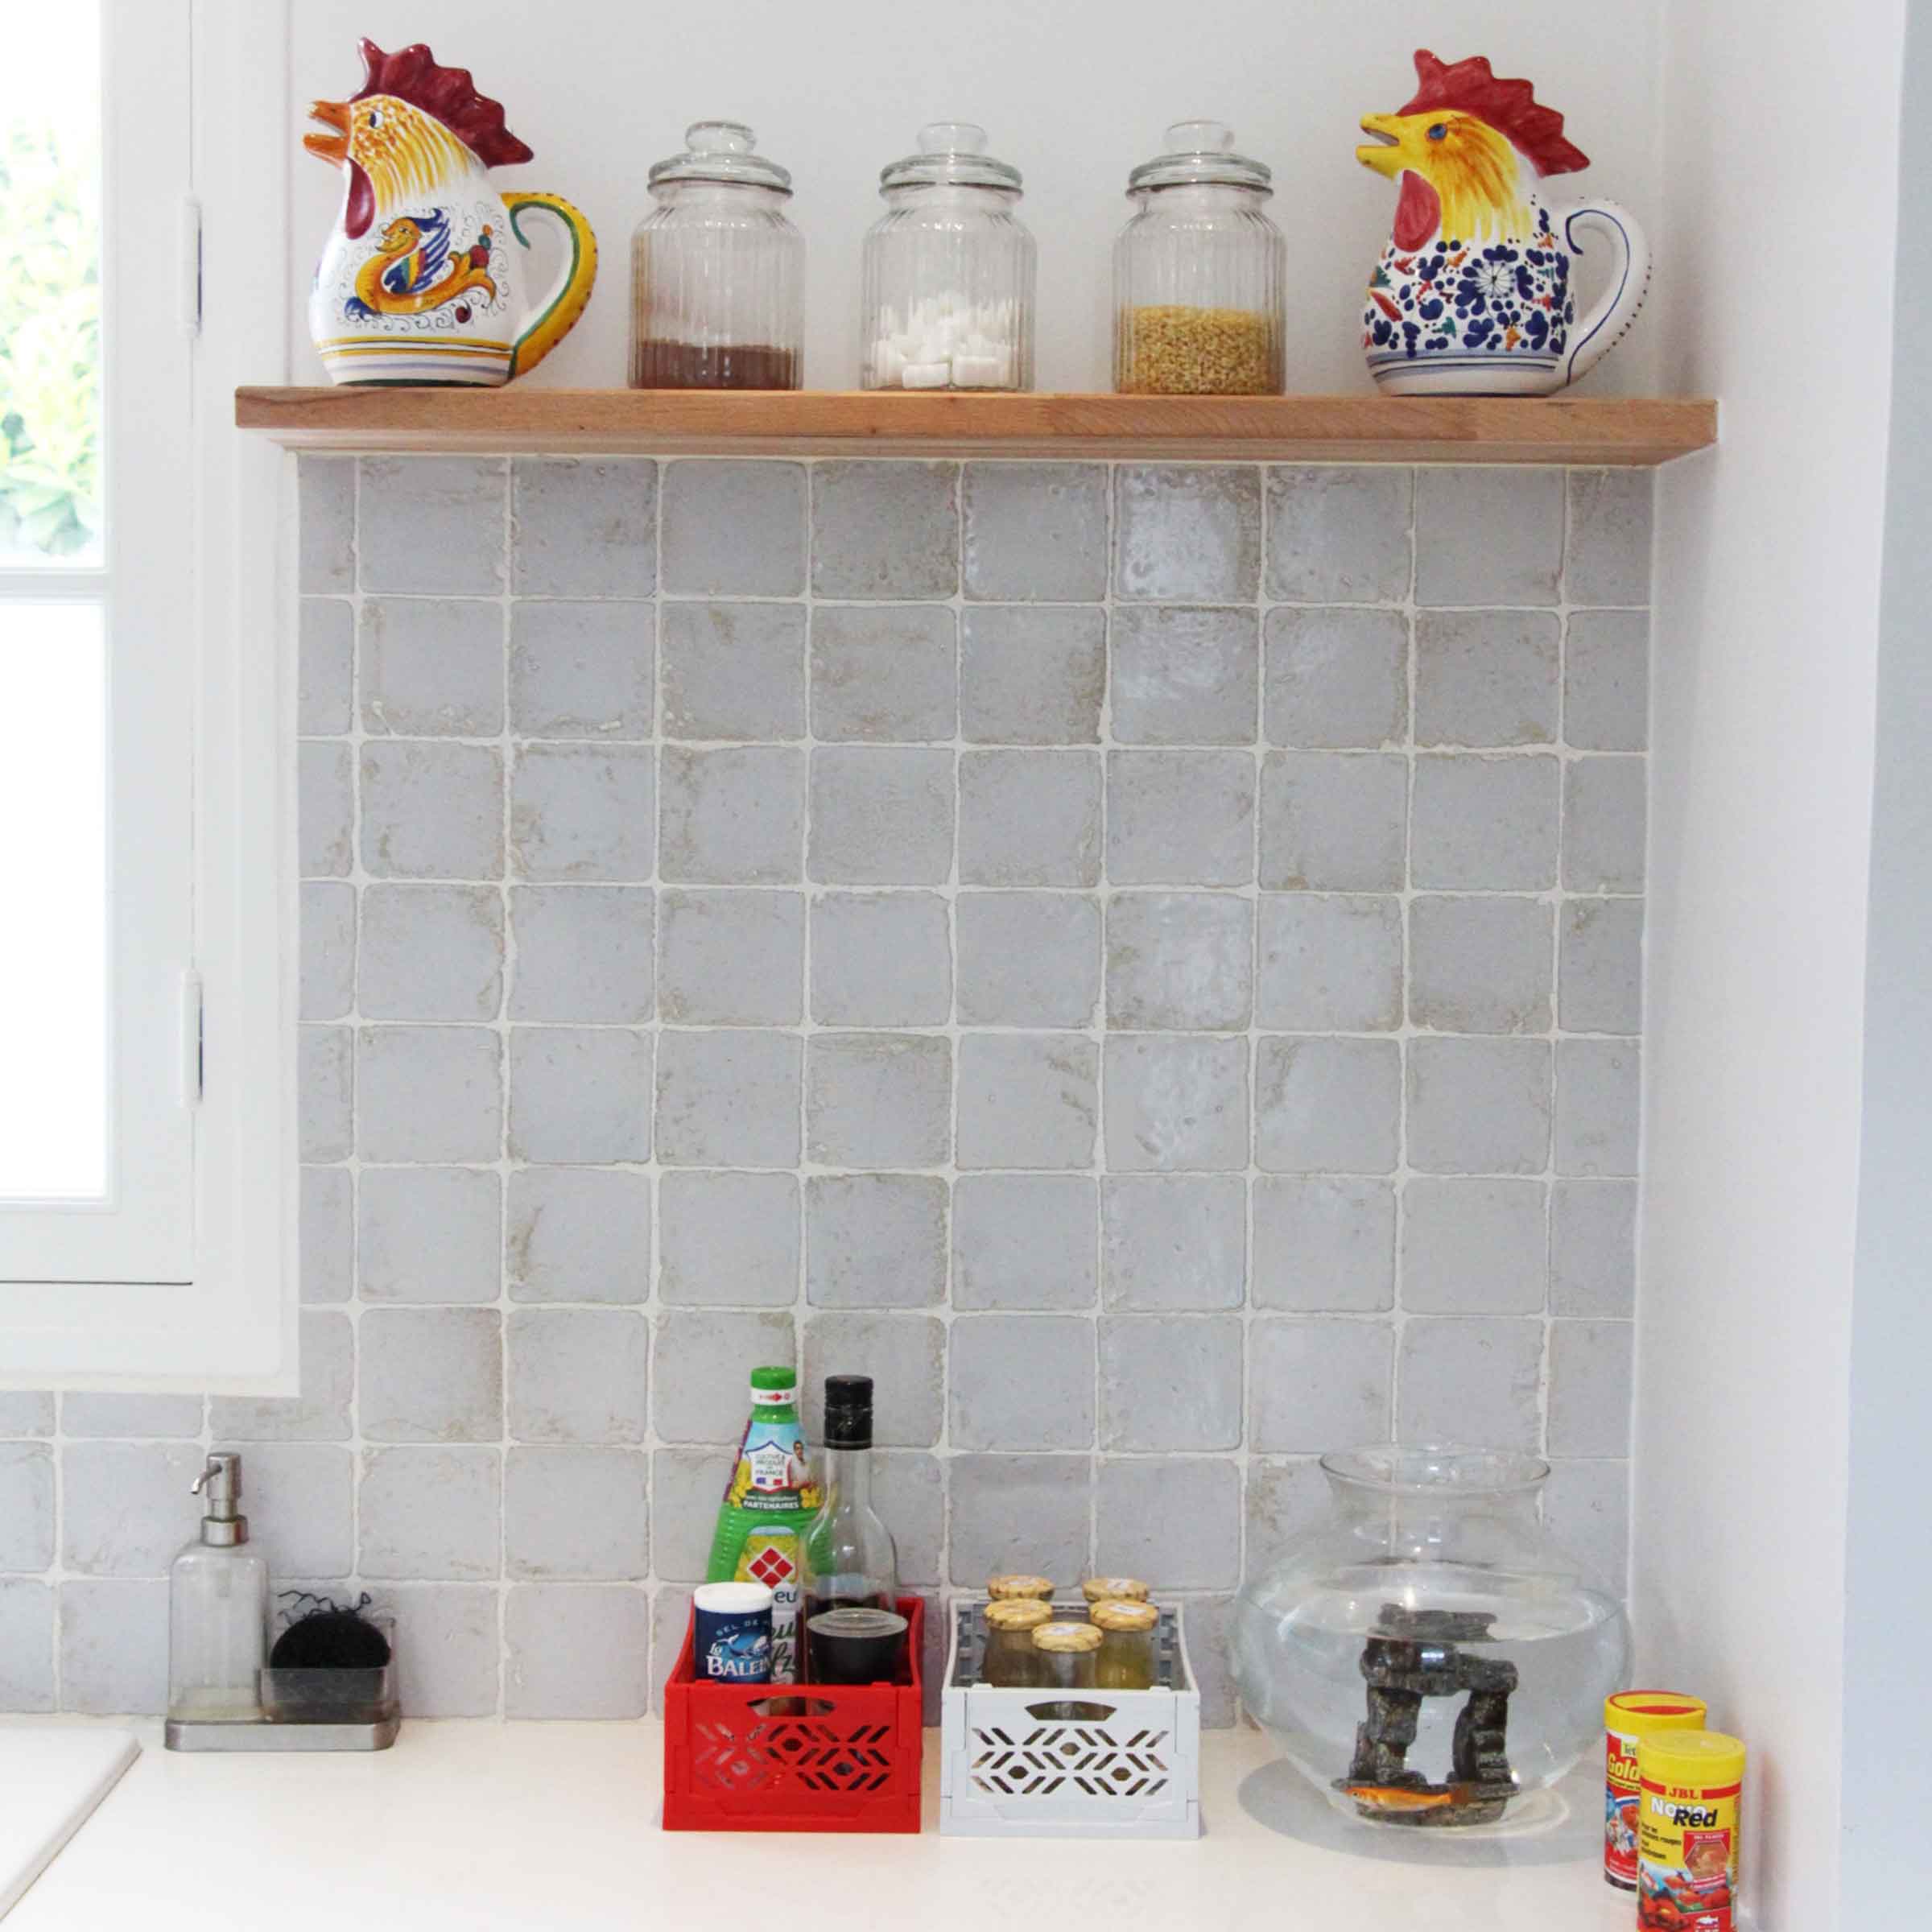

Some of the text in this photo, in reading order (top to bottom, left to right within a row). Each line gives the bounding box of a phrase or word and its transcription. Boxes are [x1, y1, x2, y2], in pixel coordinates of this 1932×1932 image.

[743, 1501, 799, 1509] PARTENAIRES
[774, 1591, 798, 1604] eu
[716, 1624, 737, 1636] SEL
[1625, 1743, 1636, 1756] Tet
[1608, 1752, 1641, 1780] Gold
[1669, 1788, 1699, 1799] JBL
[1673, 1809, 1718, 1827] Red
